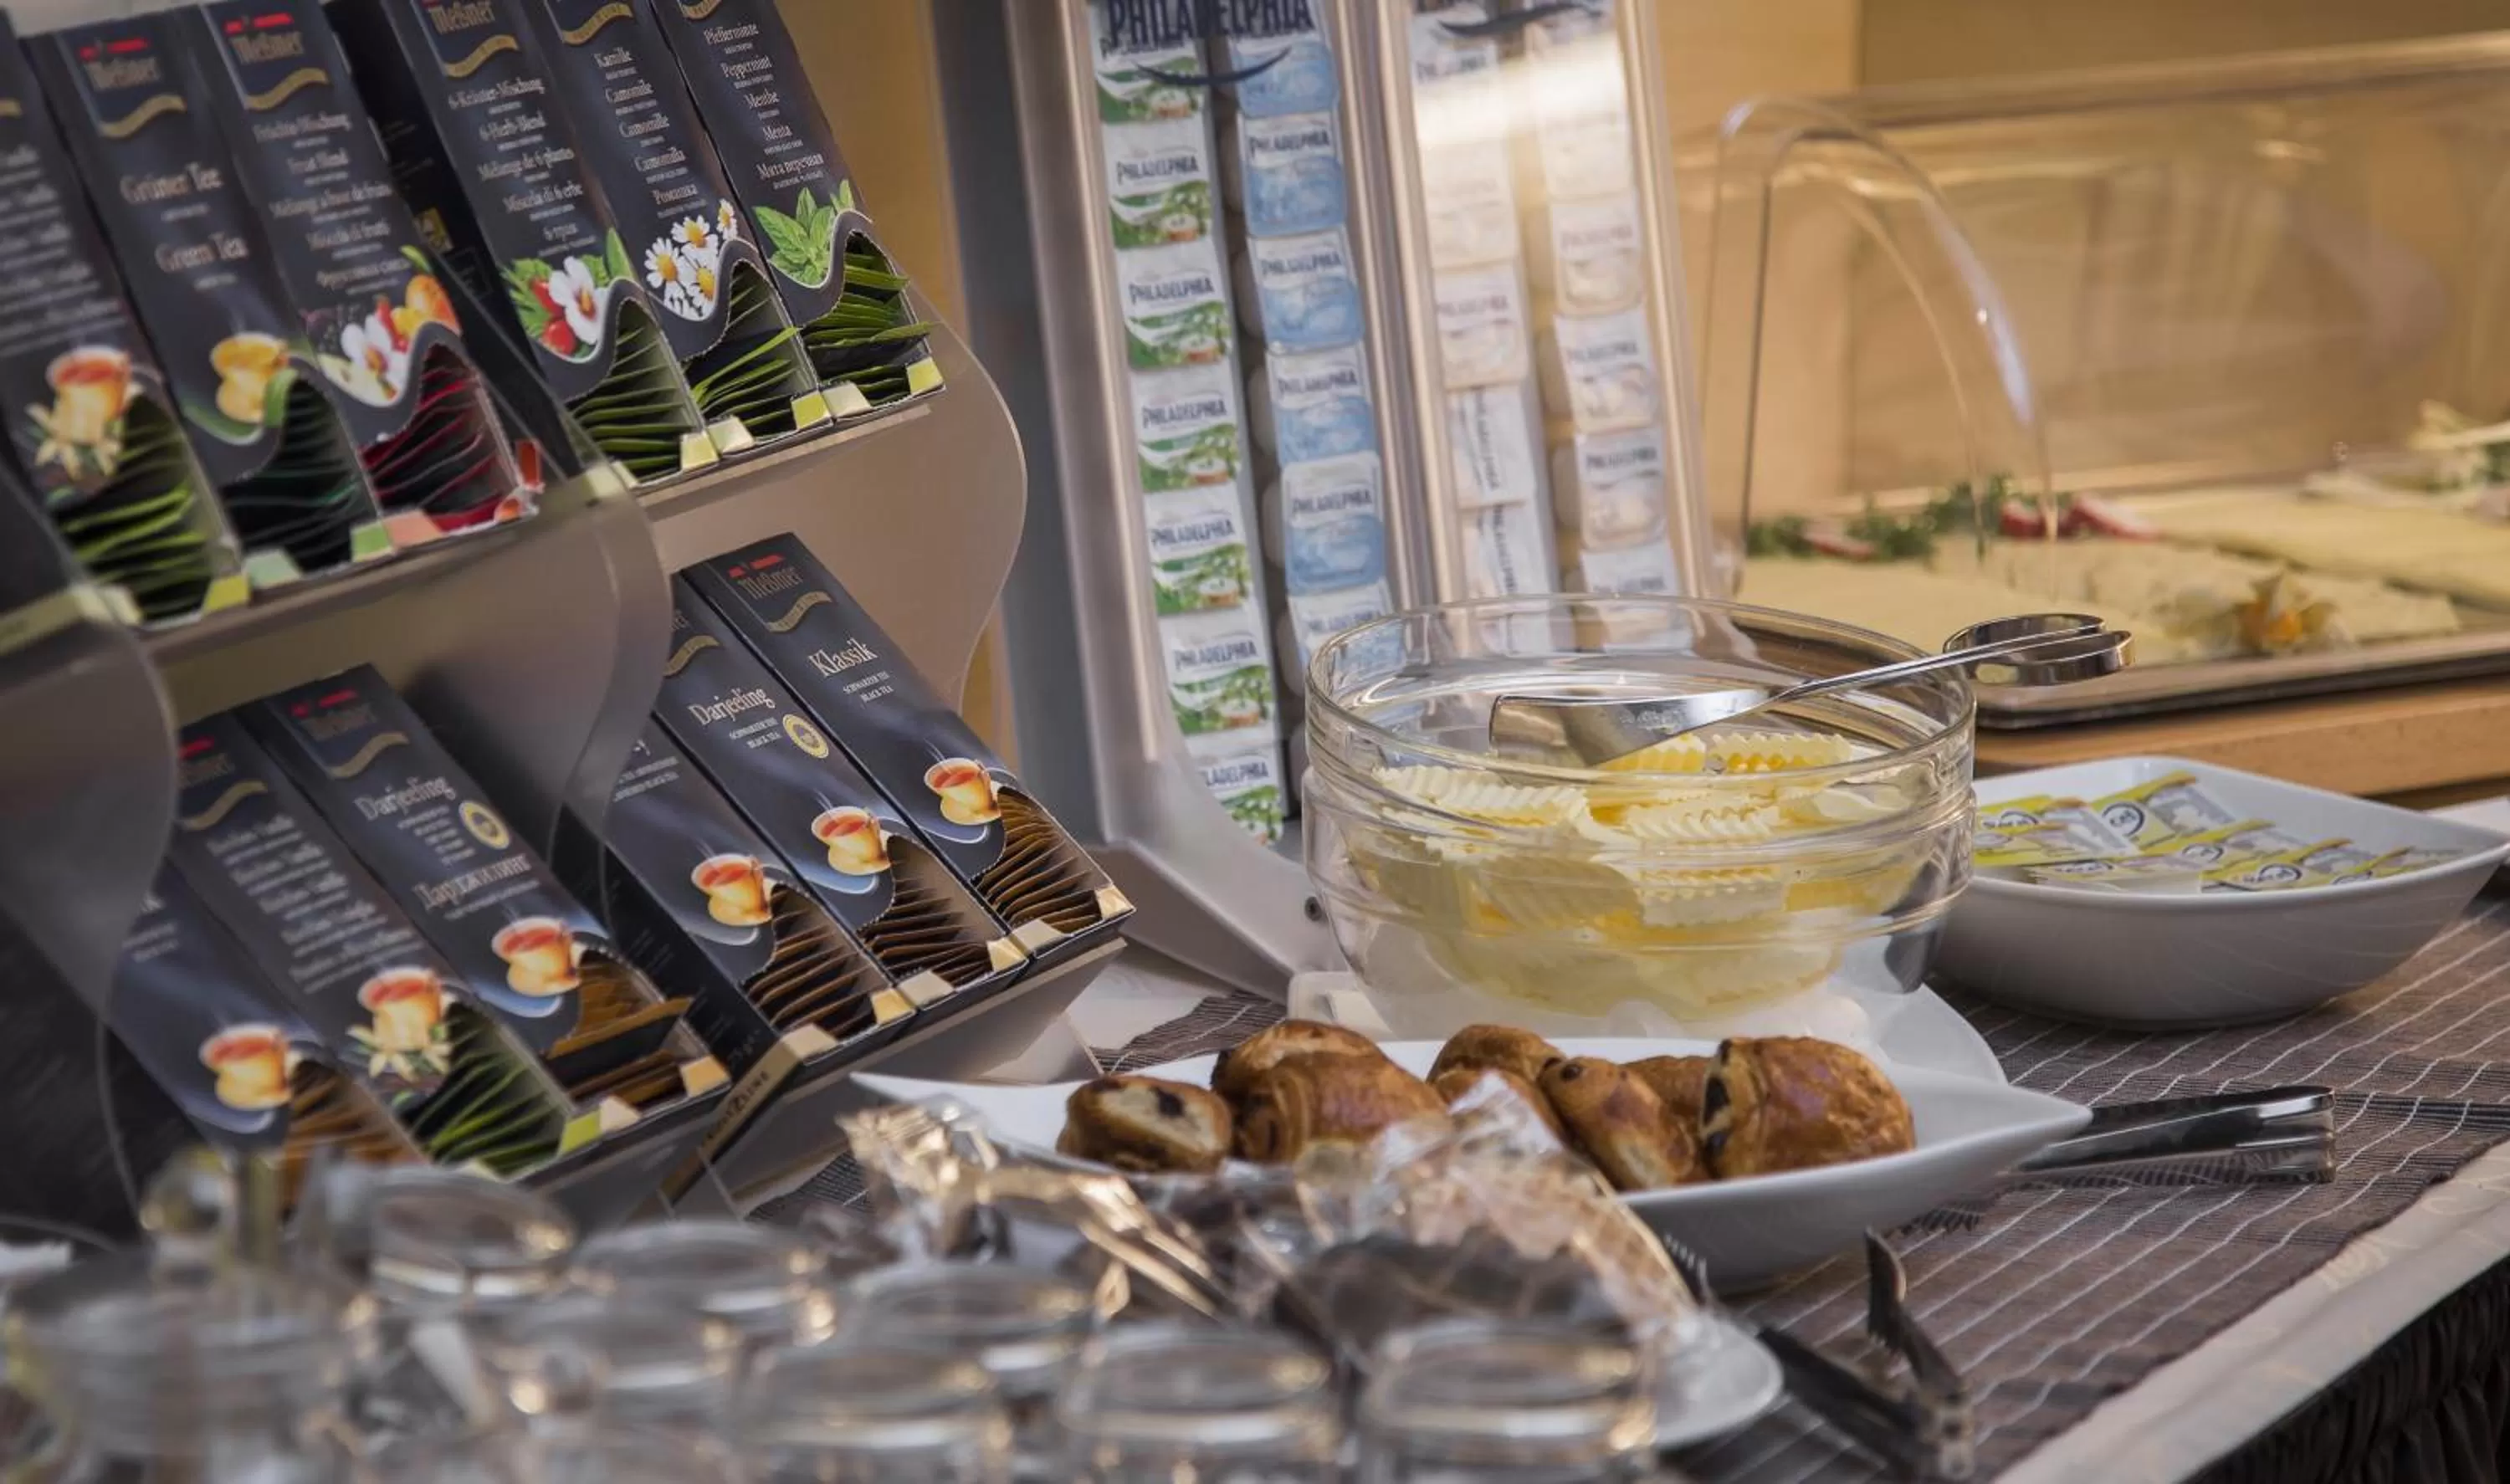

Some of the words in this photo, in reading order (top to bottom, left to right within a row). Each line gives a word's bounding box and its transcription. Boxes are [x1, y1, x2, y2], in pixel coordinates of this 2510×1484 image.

[1109, 0, 1314, 48] PHILAELPHIA
[720, 55, 772, 79] Peppermint
[1130, 277, 1215, 304] PHILADELPHIA
[1151, 519, 1235, 546] PHILADELPHIA
[808, 637, 878, 677] Klassik
[1175, 640, 1256, 668] PHILADELPHIA
[688, 688, 776, 726] Darjeeling
[1201, 761, 1269, 787] LADELPHIA
[353, 776, 456, 821] Darjeeling
